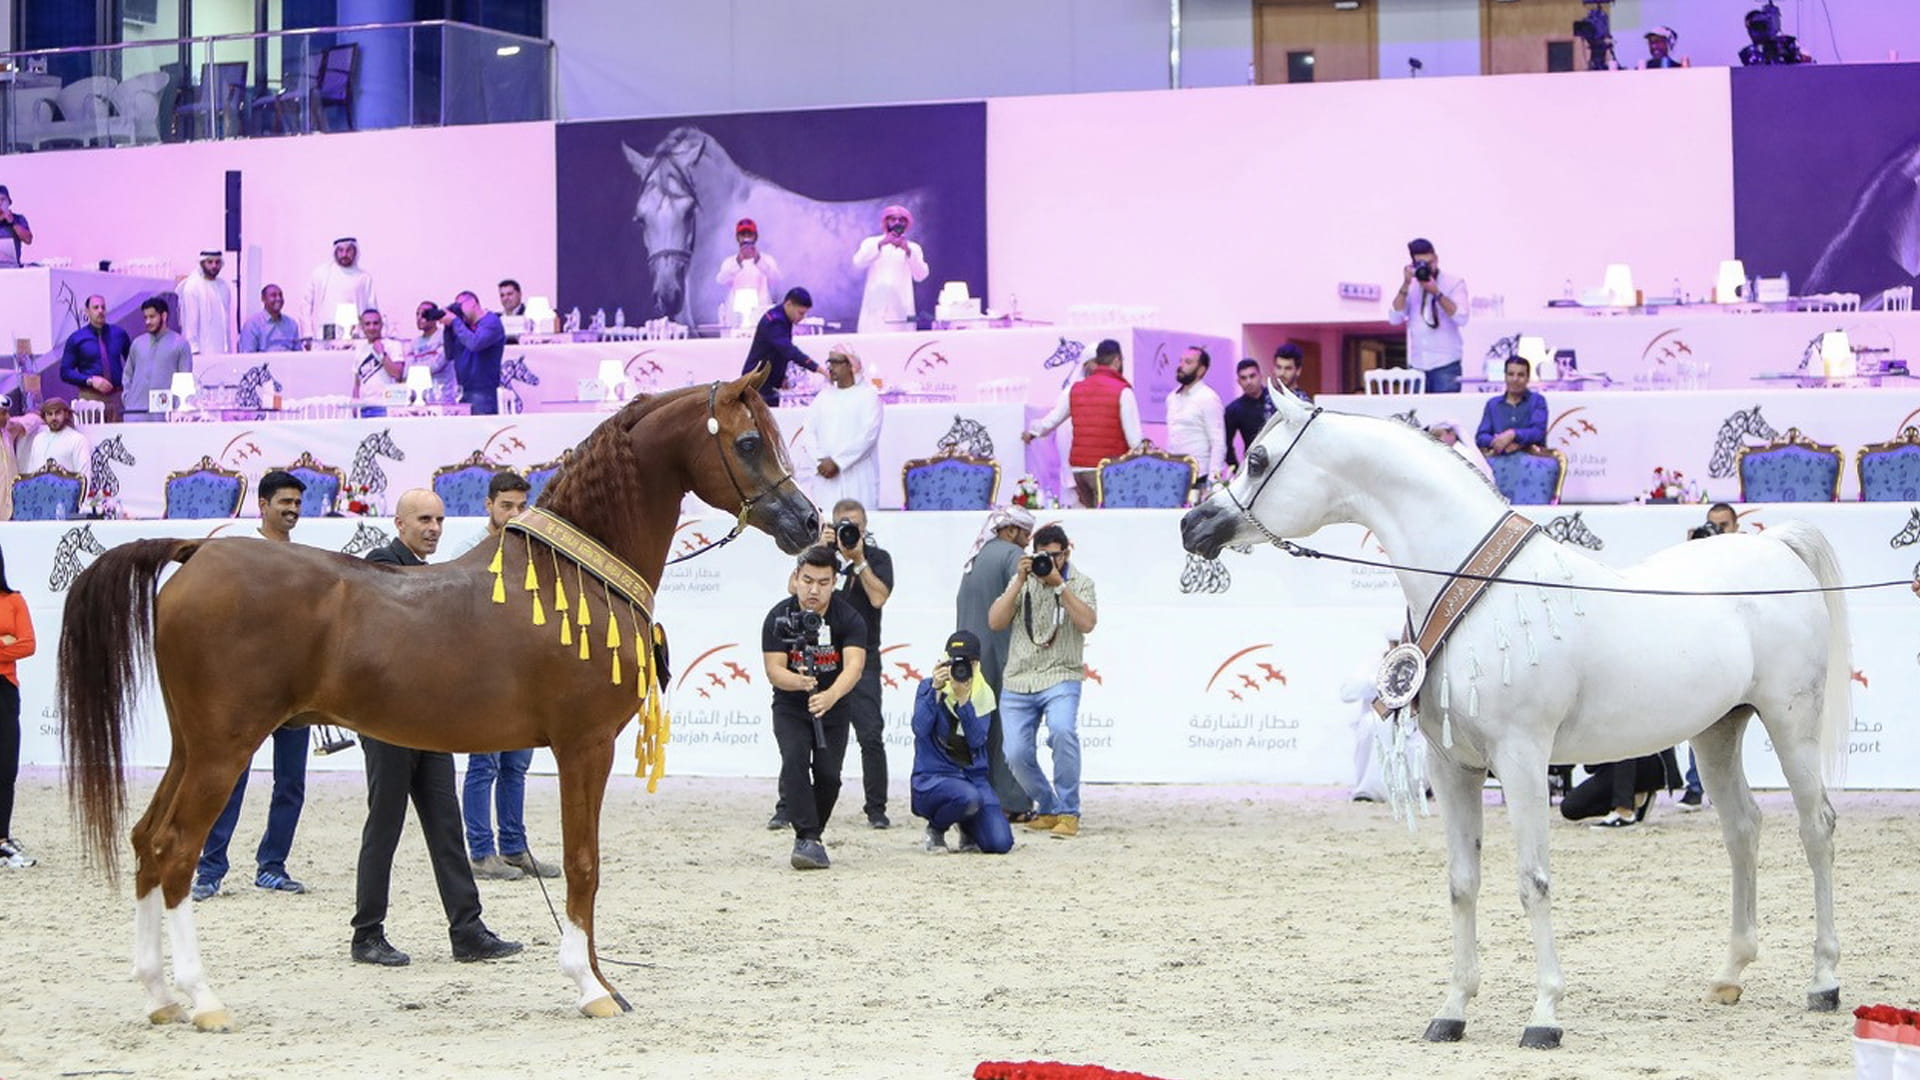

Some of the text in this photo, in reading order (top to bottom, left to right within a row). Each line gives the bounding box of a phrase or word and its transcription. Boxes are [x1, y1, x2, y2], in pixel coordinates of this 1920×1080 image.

[724, 710, 762, 727] مطار
[1188, 712, 1300, 732] مطار الشارقة
[711, 731, 759, 745] Airport
[885, 733, 913, 747] Airp
[1082, 735, 1113, 750] port
[1187, 735, 1298, 751] Sharjah Airport
[1848, 740, 1881, 754] port
